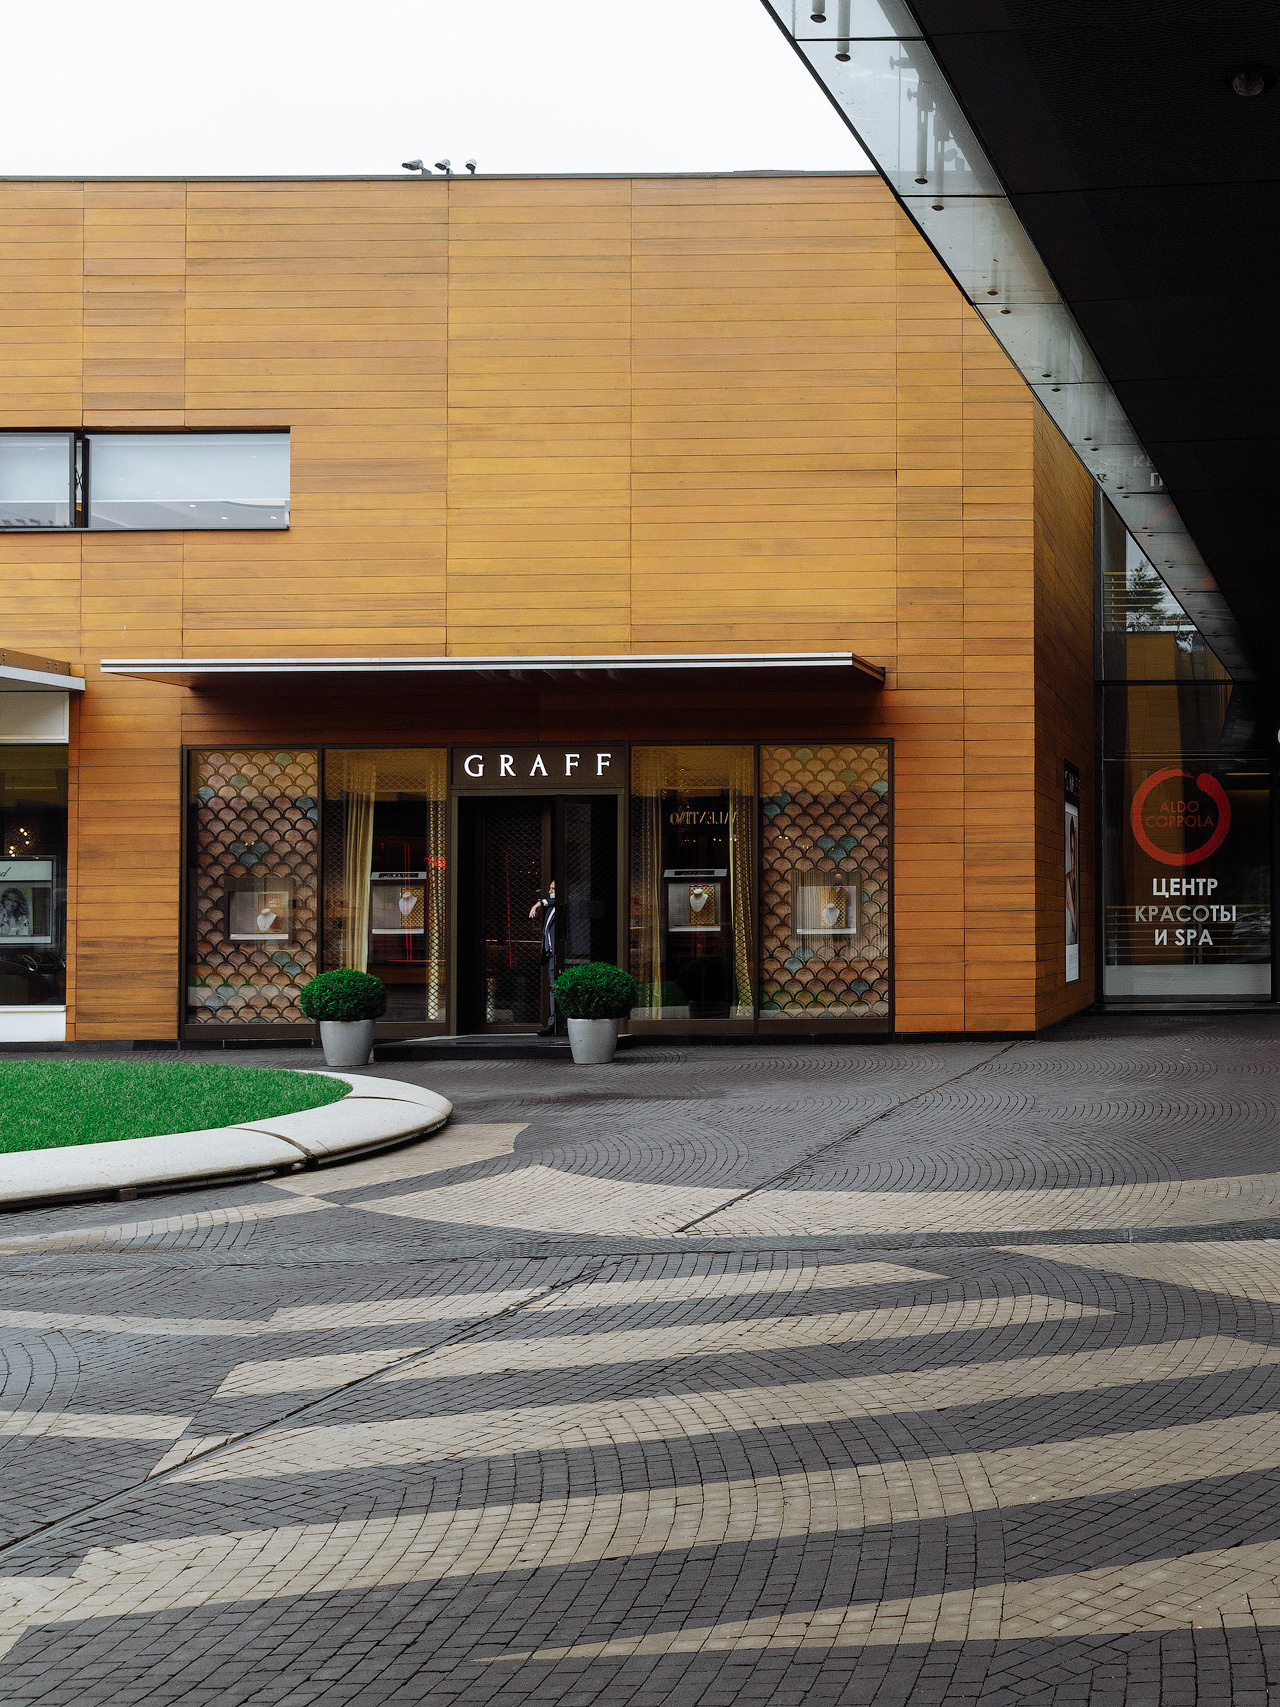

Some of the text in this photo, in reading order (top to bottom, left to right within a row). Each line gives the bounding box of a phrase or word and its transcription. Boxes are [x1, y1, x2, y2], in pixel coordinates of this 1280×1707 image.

[464, 753, 611, 777] GRAFF
[1160, 801, 1199, 813] ALDO
[1145, 815, 1214, 828] COPPOLA
[1152, 878, 1218, 898] ЦЕНТР
[1135, 905, 1237, 922] КРАСОТЫ
[1154, 929, 1214, 946] И SPA
